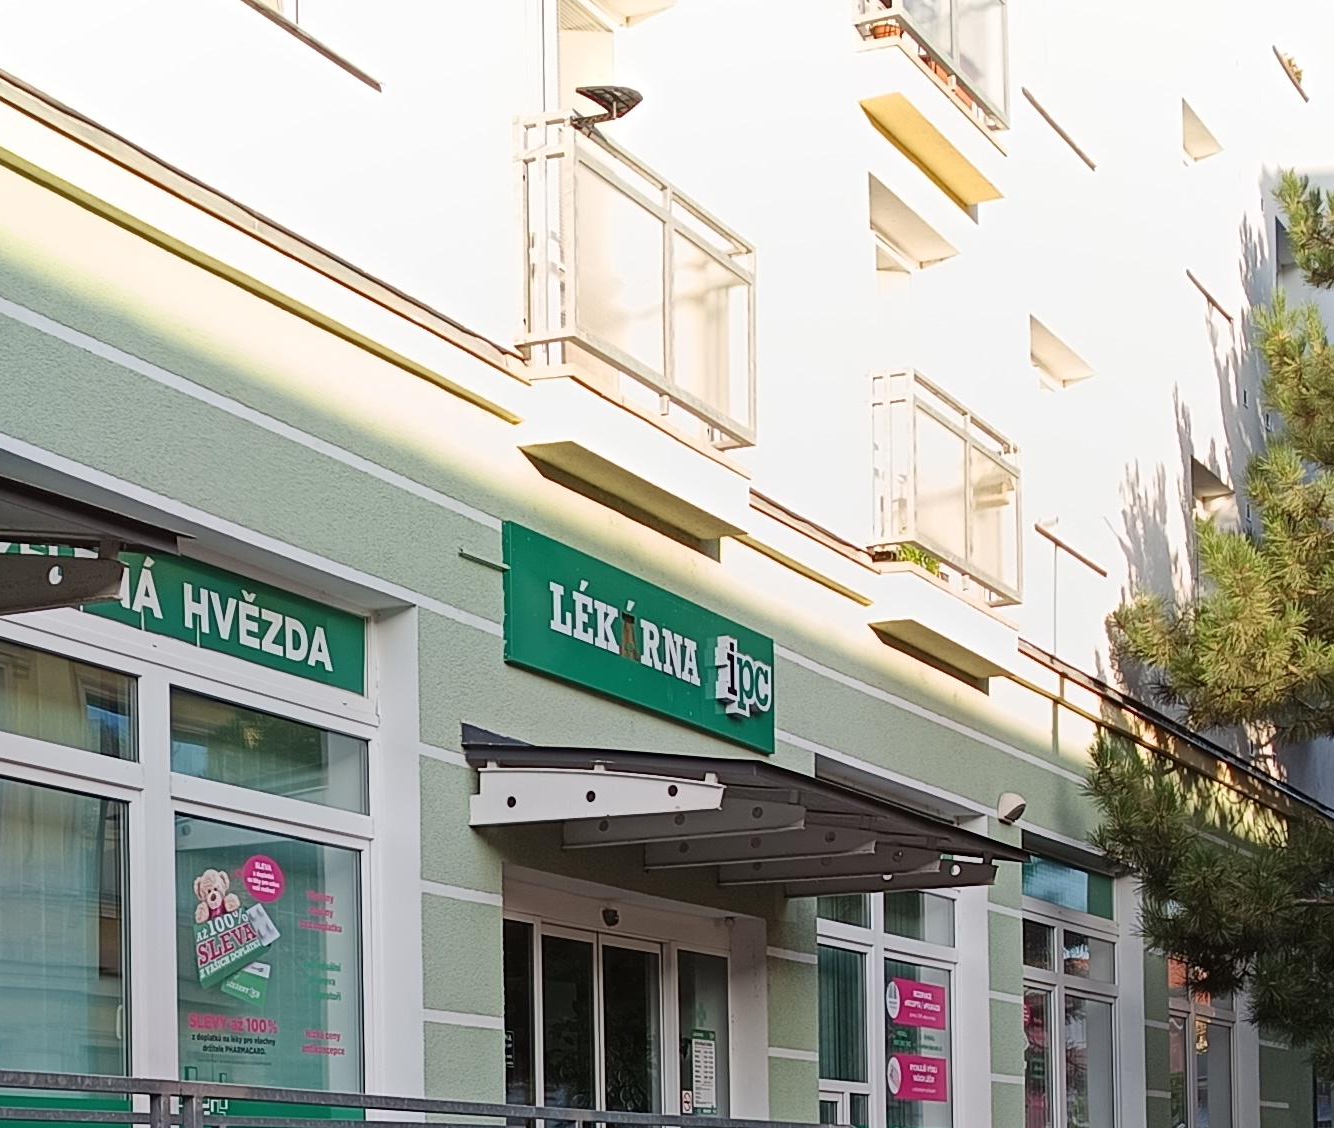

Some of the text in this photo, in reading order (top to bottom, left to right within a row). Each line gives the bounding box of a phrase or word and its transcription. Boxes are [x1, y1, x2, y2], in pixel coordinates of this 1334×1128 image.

[183, 582, 334, 672] HVĚZDA
[197, 922, 258, 968] SLEVA
[208, 908, 248, 936] 100%
